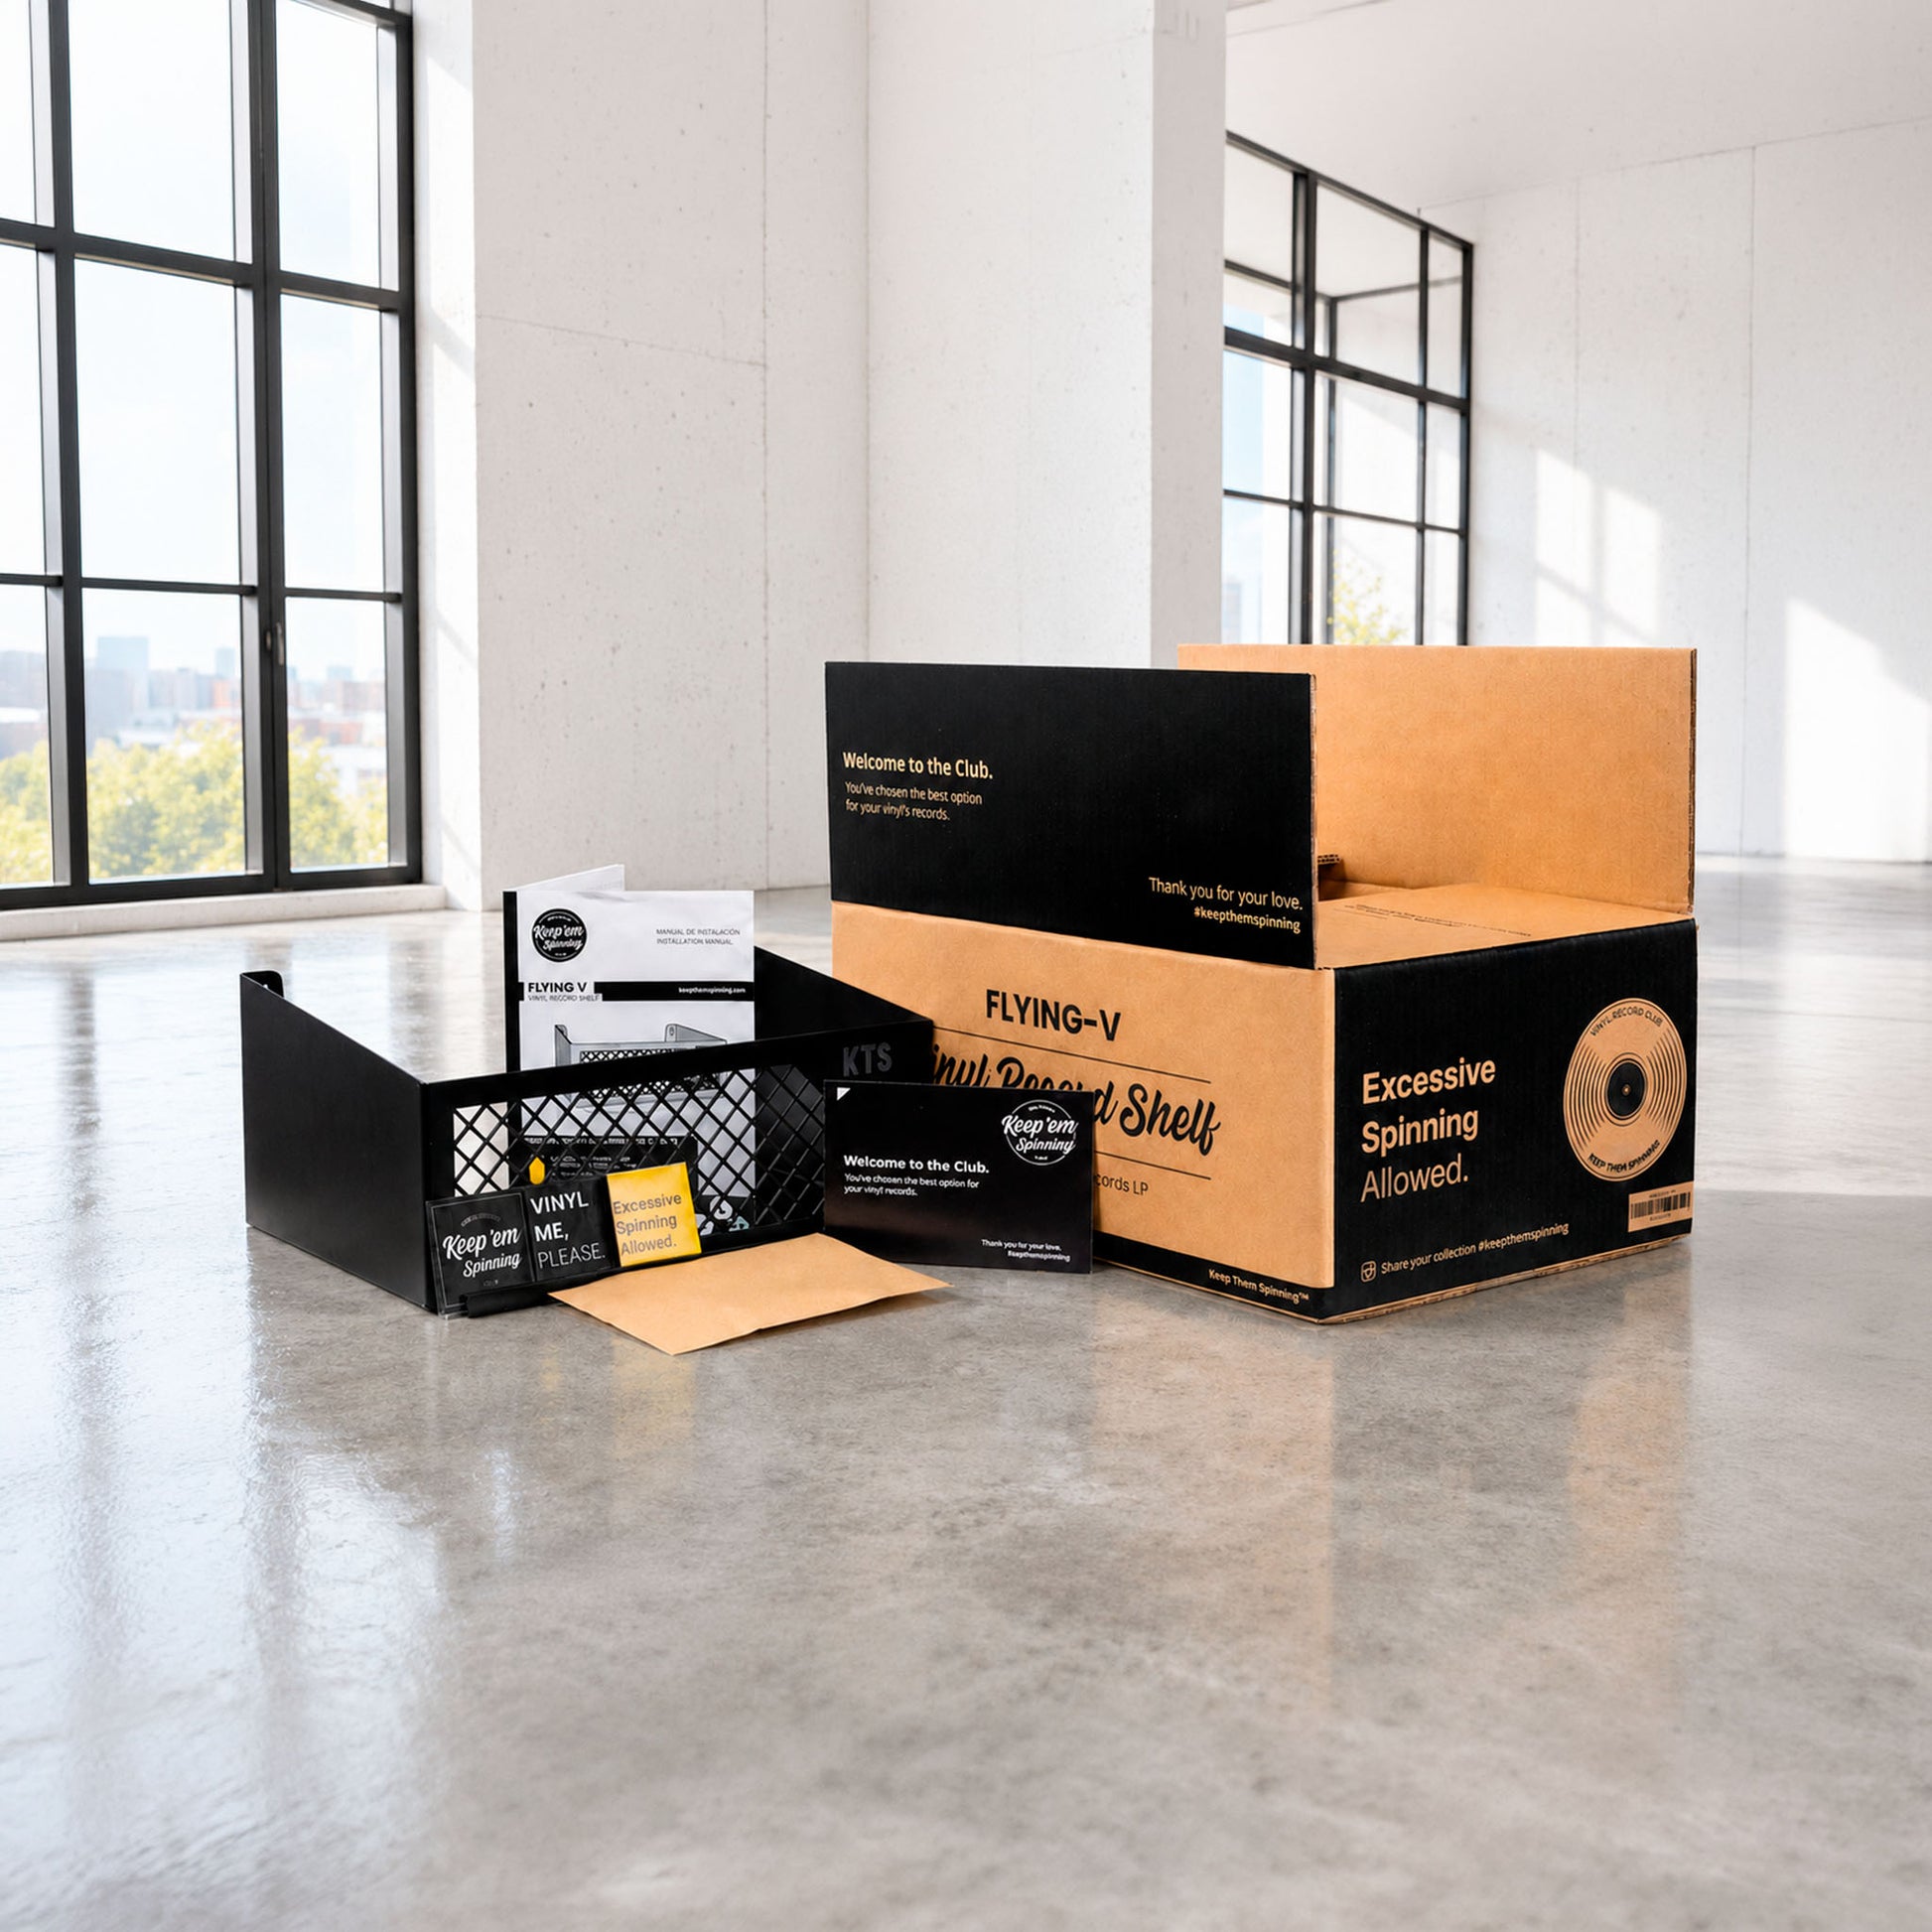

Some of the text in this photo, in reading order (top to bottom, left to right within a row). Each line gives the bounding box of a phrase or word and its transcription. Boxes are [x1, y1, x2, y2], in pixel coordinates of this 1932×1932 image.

[843, 752, 993, 779] Welcome to the Club.
[845, 781, 982, 806] You've chosen the best option
[845, 798, 950, 821] for your vinyl's records.
[1149, 877, 1303, 910] Thank you for your love.
[1194, 905, 1301, 934] #keepthemspinning
[528, 982, 588, 993] FLYING V
[1612, 1006, 1644, 1019] RECORD
[843, 1041, 893, 1077] KTS
[1363, 1056, 1496, 1105] Excessive
[933, 1043, 991, 1087] inyl
[1119, 1083, 1221, 1157] Shelf
[1001, 1114, 1079, 1139] Keep 'em
[1361, 1107, 1478, 1158] Spinning
[844, 1155, 990, 1173] Welcome to the Club.
[844, 1185, 863, 1195] your
[903, 1175, 918, 1185] the
[919, 1177, 938, 1186] best
[938, 1178, 966, 1188] option
[967, 1178, 980, 1188] for
[1094, 1173, 1149, 1195] cords LP
[1360, 1152, 1468, 1203] Allowed.
[530, 1191, 590, 1214] VINYL
[613, 1193, 682, 1215] Excessive
[534, 1222, 569, 1242] ME,
[617, 1215, 678, 1237] Spinning
[442, 1227, 522, 1261] Keep 'em
[537, 1242, 607, 1270] PLEASE.
[621, 1234, 677, 1256] Allowed.
[1381, 1222, 1570, 1275] Share your collection #keepthemspinning
[463, 1253, 522, 1278] Spinning
[1208, 1268, 1231, 1286] Keep
[1232, 1275, 1258, 1292] Them
